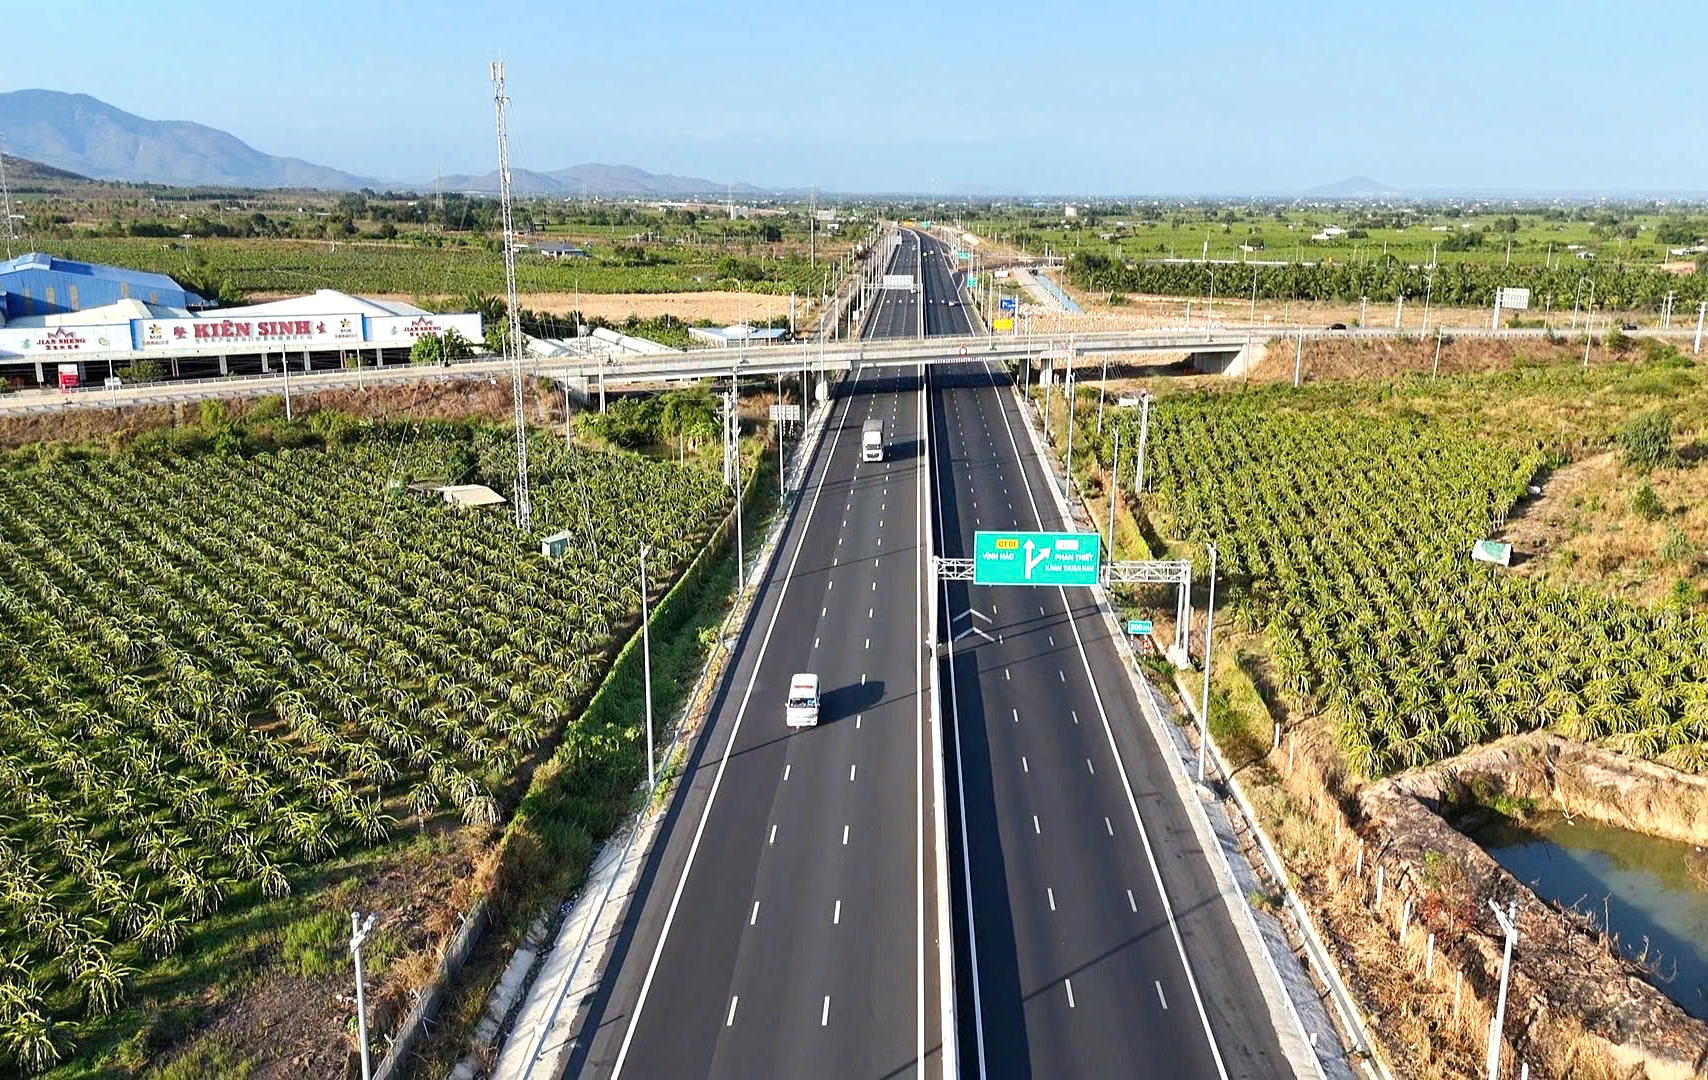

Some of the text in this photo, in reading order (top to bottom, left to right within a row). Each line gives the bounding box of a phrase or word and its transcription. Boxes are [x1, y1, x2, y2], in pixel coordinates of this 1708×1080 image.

[193, 320, 251, 338] KIÊN
[257, 320, 311, 336] SINH
[1054, 553, 1074, 561] PHAN
